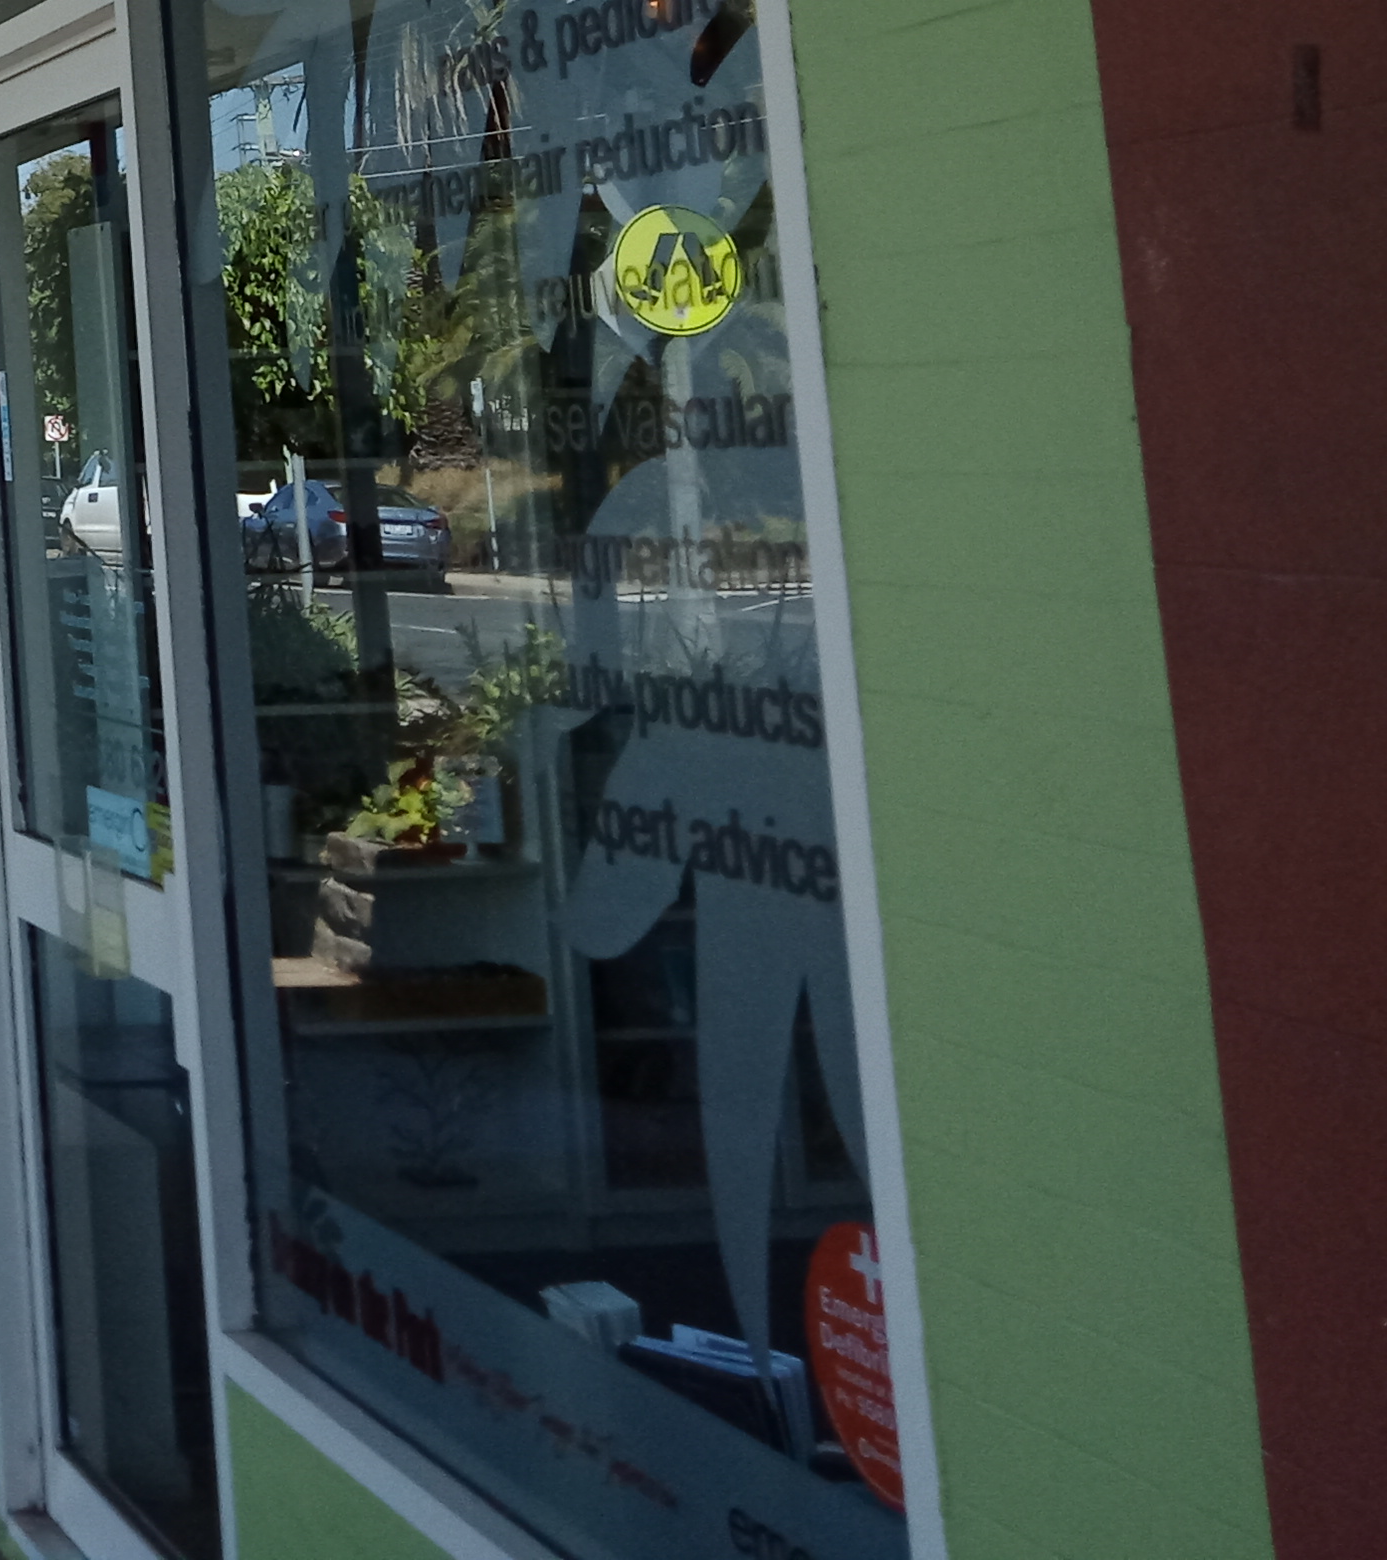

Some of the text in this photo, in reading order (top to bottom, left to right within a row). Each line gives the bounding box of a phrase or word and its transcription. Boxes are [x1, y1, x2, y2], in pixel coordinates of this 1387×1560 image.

[521, 8, 547, 73] &
[575, 95, 768, 190] reduction
[611, 384, 793, 453] vascular
[633, 664, 822, 749] products
[688, 807, 839, 905] advice
